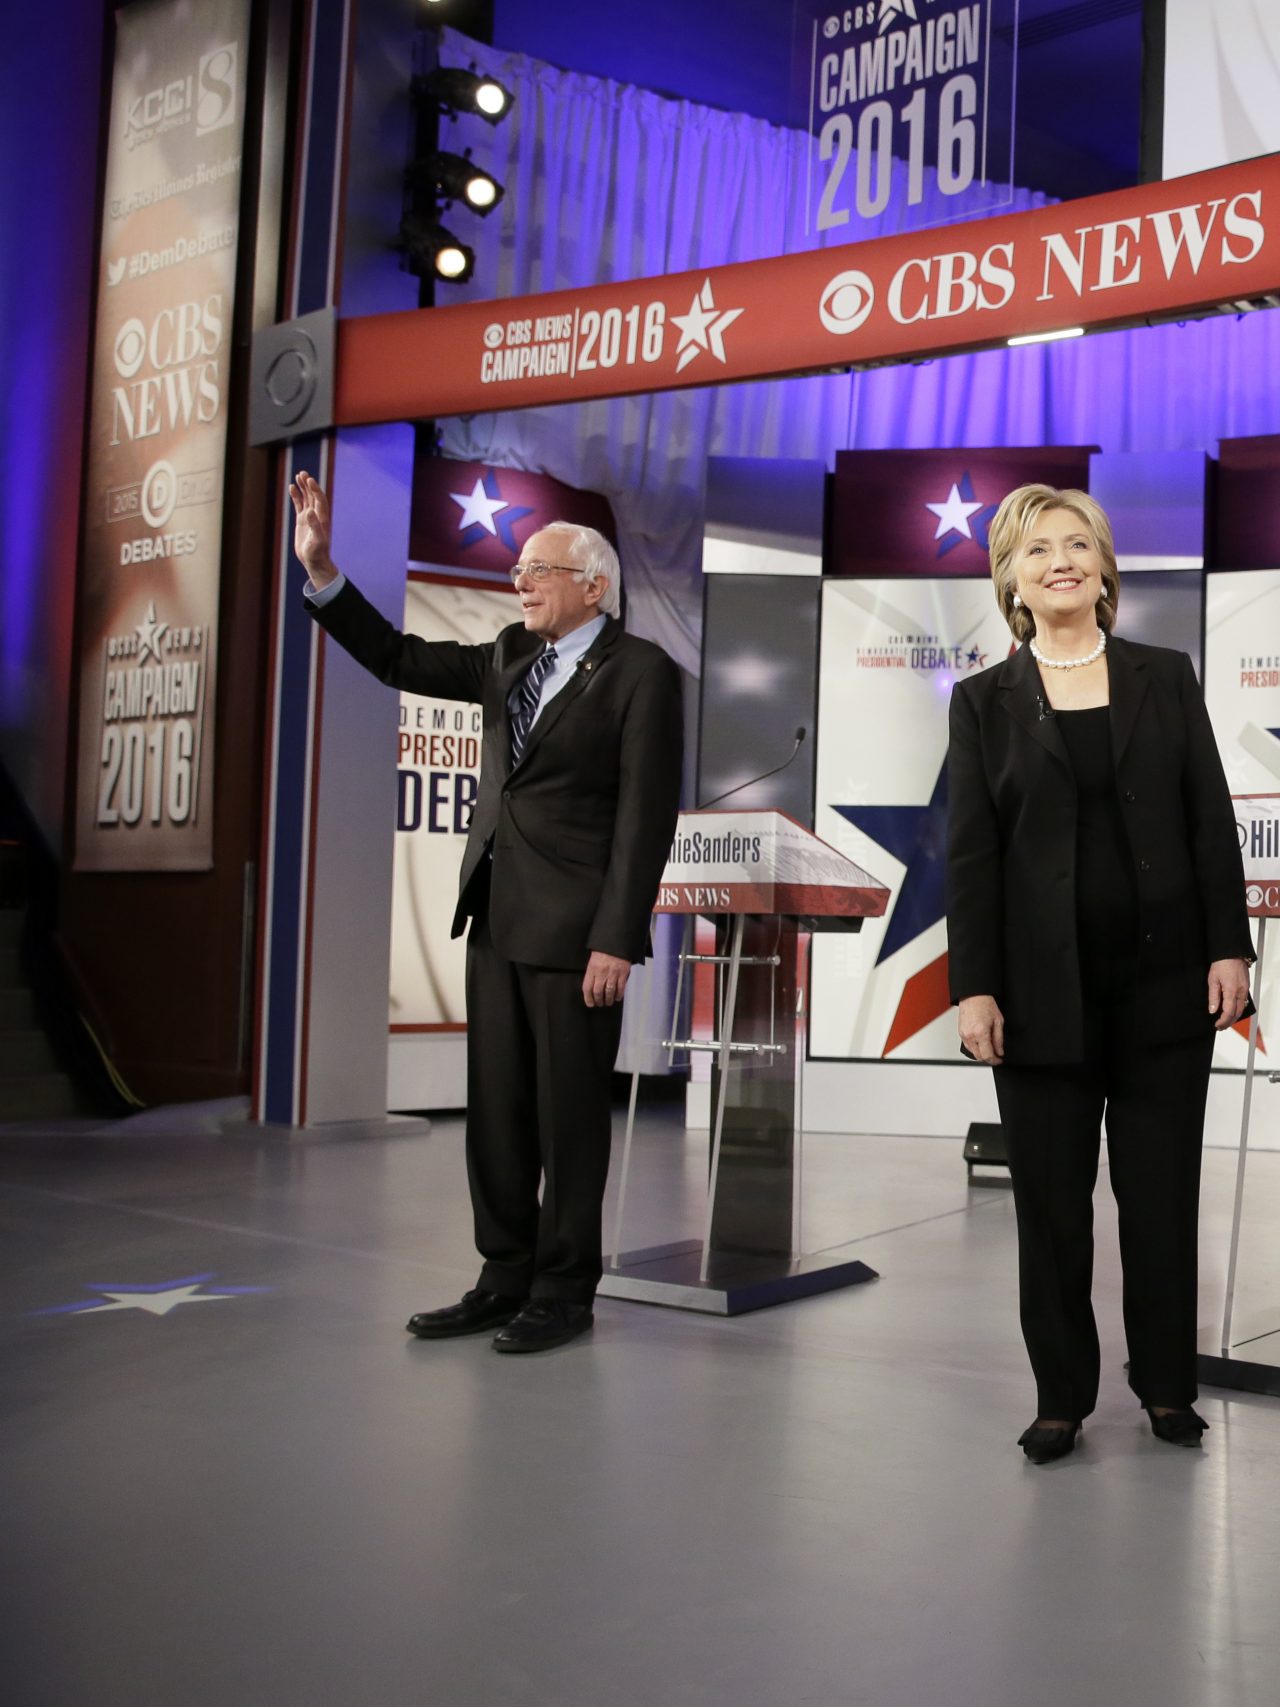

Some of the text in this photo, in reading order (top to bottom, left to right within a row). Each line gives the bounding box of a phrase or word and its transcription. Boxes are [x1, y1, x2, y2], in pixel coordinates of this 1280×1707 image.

[843, 2, 875, 33] CBS
[819, 4, 980, 112] CAMPAIGN
[123, 75, 192, 138] KCCI
[816, 74, 977, 231] 2016
[128, 223, 234, 280] #DemDebate
[886, 190, 1265, 325] CBS NEWS
[150, 294, 223, 370] CBS
[506, 313, 573, 346] CBS NEWS
[577, 301, 667, 372] 2016
[480, 342, 571, 384] CAMPAIGN
[109, 360, 220, 446] NEWS
[120, 529, 198, 566] DEBATES
[911, 646, 962, 669] DEBATE
[104, 660, 200, 720] CAMPAIGN
[97, 718, 195, 824] 2016
[397, 733, 479, 769] PRESID
[396, 770, 478, 834] DEB
[657, 887, 730, 906] BS NEWS
